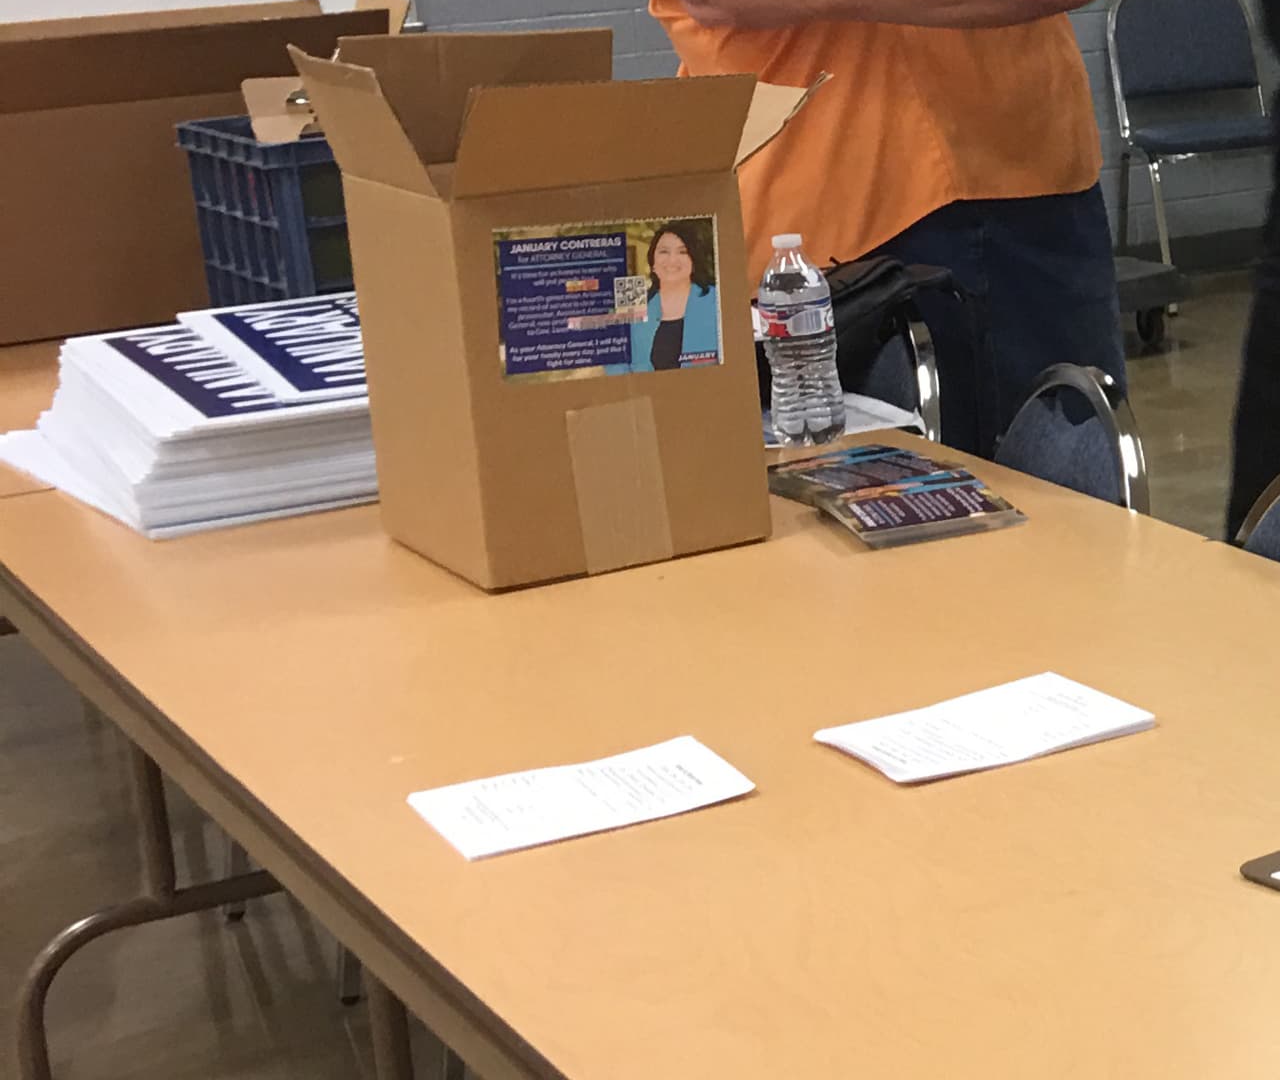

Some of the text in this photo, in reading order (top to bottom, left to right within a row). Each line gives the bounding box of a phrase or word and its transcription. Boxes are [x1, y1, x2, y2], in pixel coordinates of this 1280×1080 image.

[510, 236, 622, 254] JANUARY CONTRERAS
[530, 251, 570, 262] ATTORNEY
